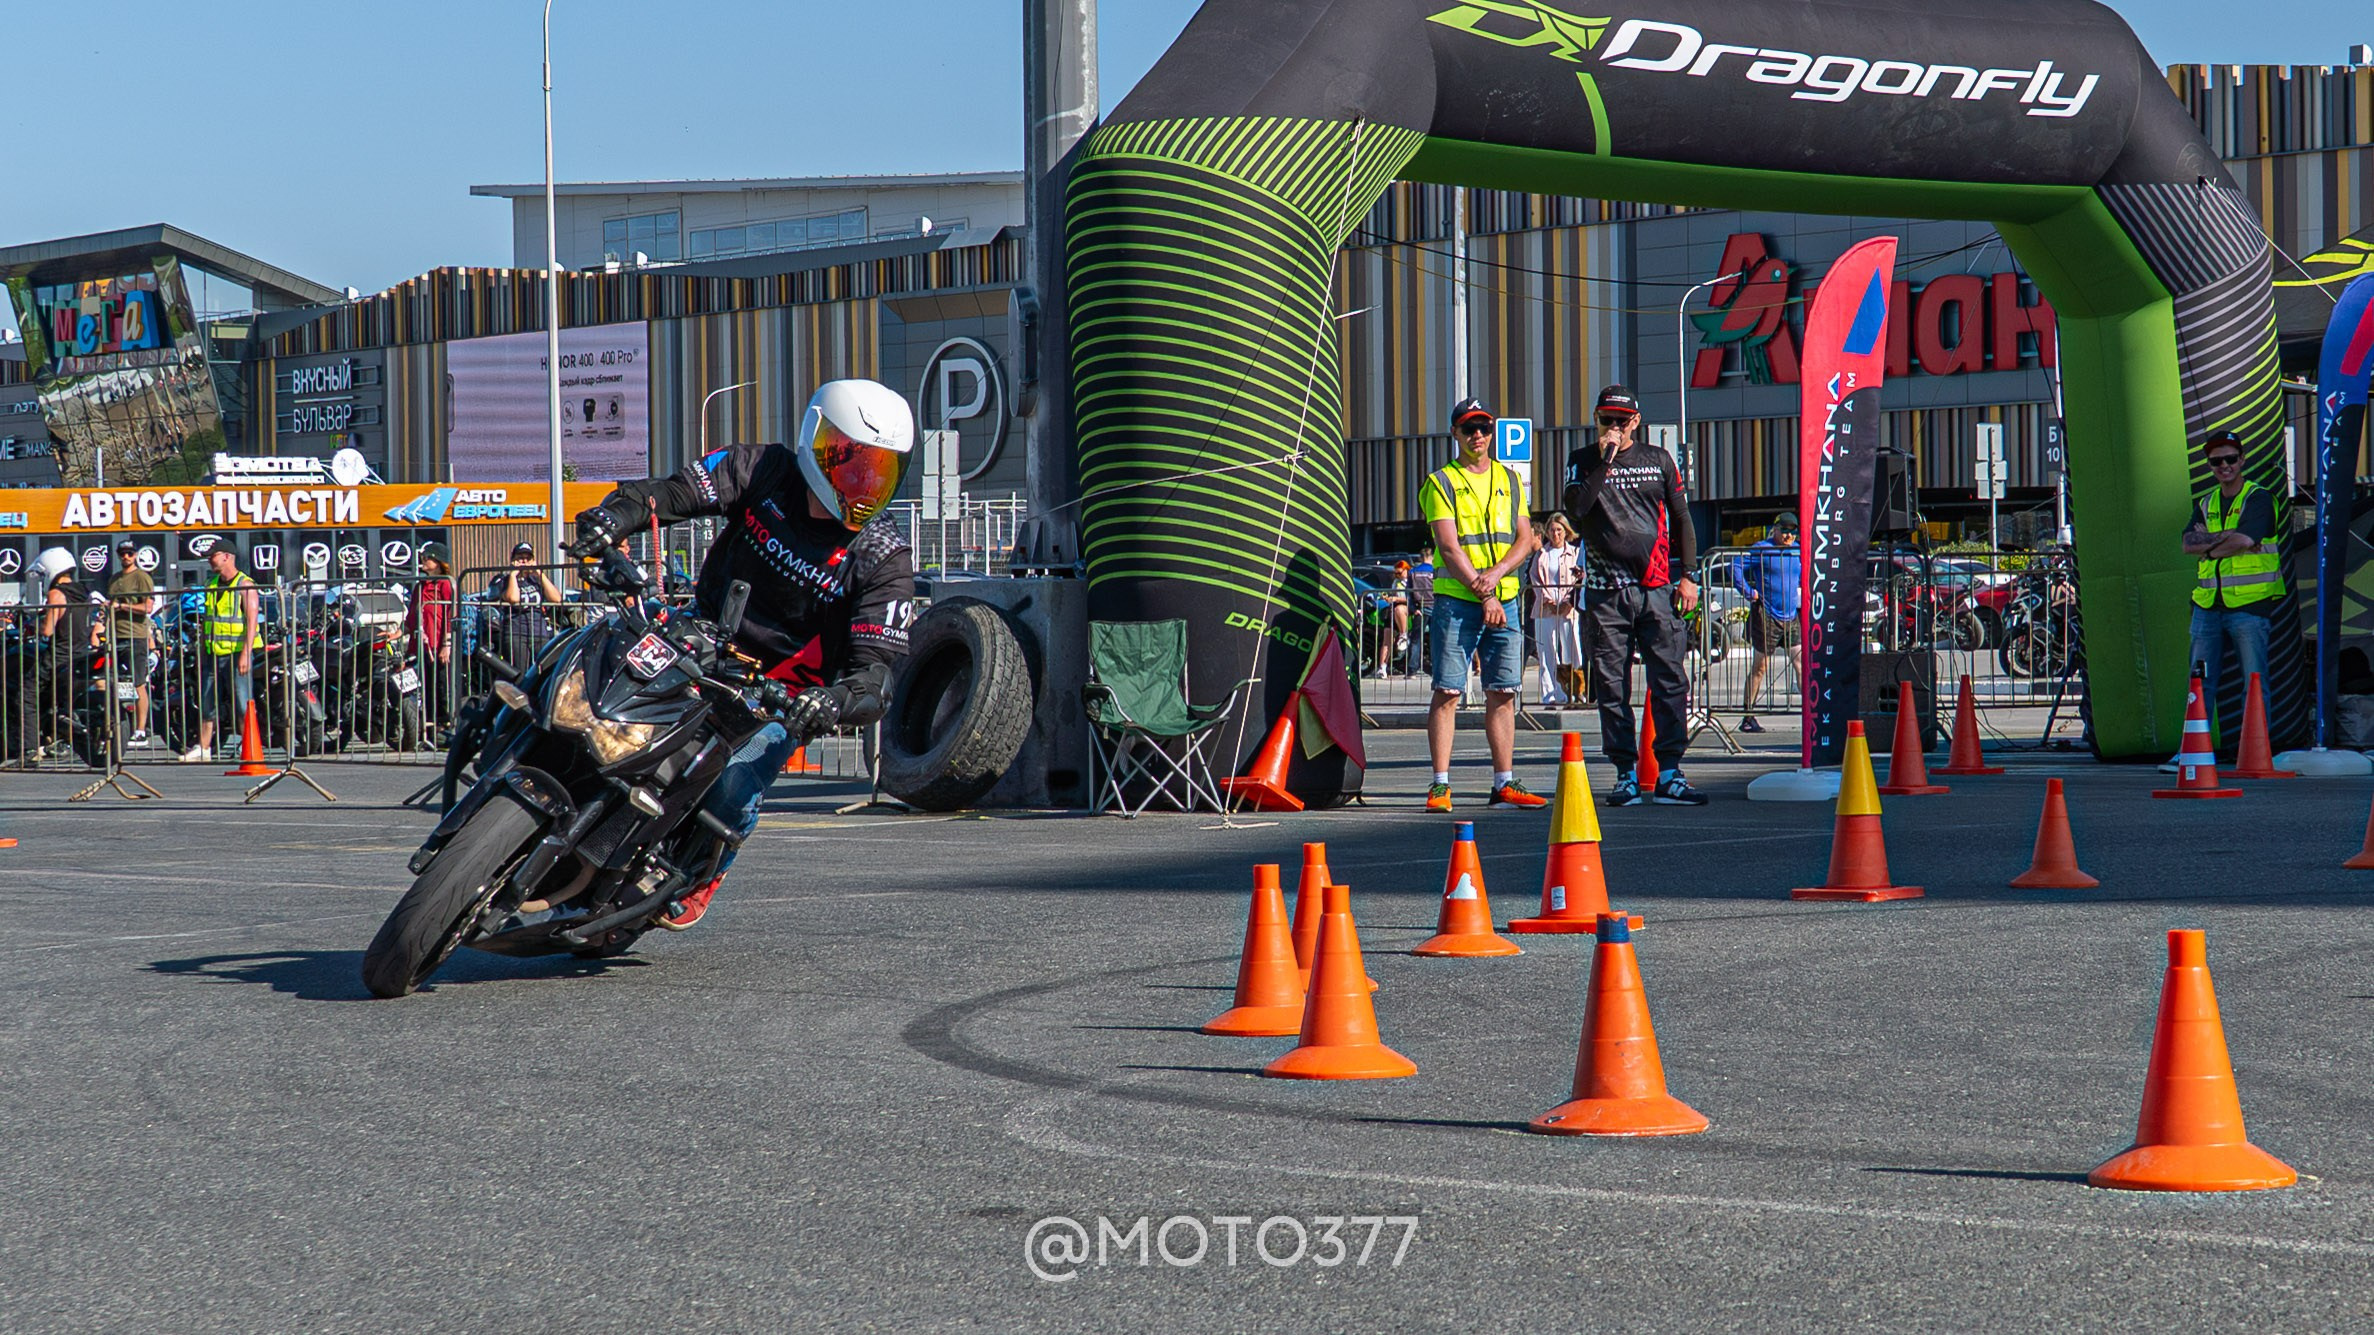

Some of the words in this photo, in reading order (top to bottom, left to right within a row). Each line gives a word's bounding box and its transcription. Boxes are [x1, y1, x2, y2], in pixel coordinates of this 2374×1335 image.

[541, 354, 576, 371] HOR
[579, 352, 594, 367] 400
[600, 350, 615, 365] 400
[617, 349, 633, 364] Pro
[292, 357, 352, 394] ВКУСНЫЙ
[293, 404, 352, 433] БУЛЬВАР
[1506, 424, 1525, 457] P
[2046, 447, 2060, 462] 10
[1605, 475, 1658, 484] ATERINBURG
[61, 489, 359, 527] АВТОЗАПЧАСТИ
[455, 489, 506, 503] АВТО
[0, 512, 28, 527] ЕЦ
[452, 504, 547, 520] ЕВРОПЕЕЦ
[1821, 486, 1846, 746] EKATERINBURG
[1839, 372, 1857, 458] TEAM
[885, 600, 911, 629] 19
